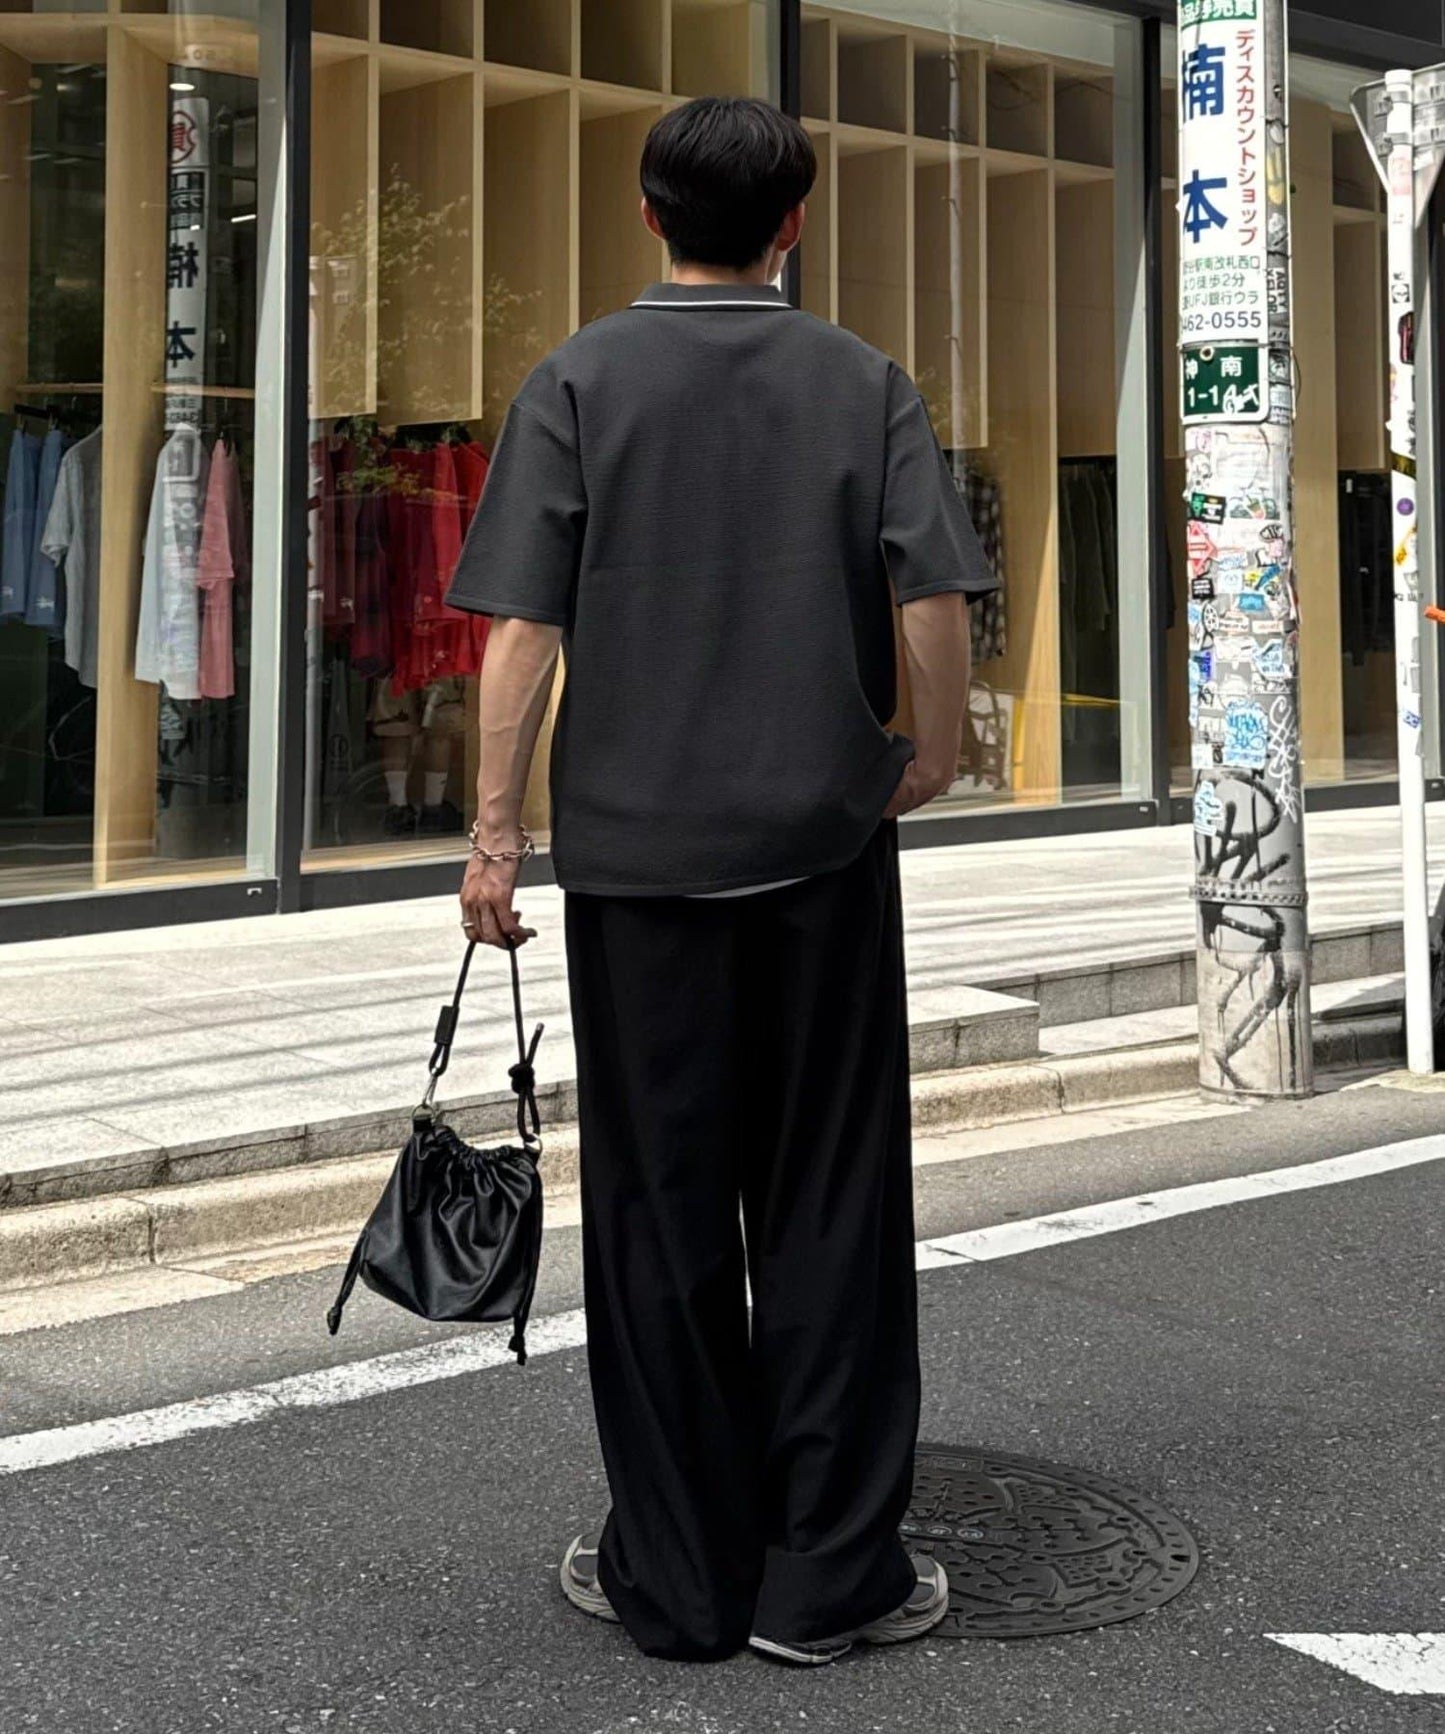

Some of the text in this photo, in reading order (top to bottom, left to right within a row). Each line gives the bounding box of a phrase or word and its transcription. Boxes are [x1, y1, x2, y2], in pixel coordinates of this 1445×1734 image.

[1236, 29, 1257, 246] ディスカウントショップ
